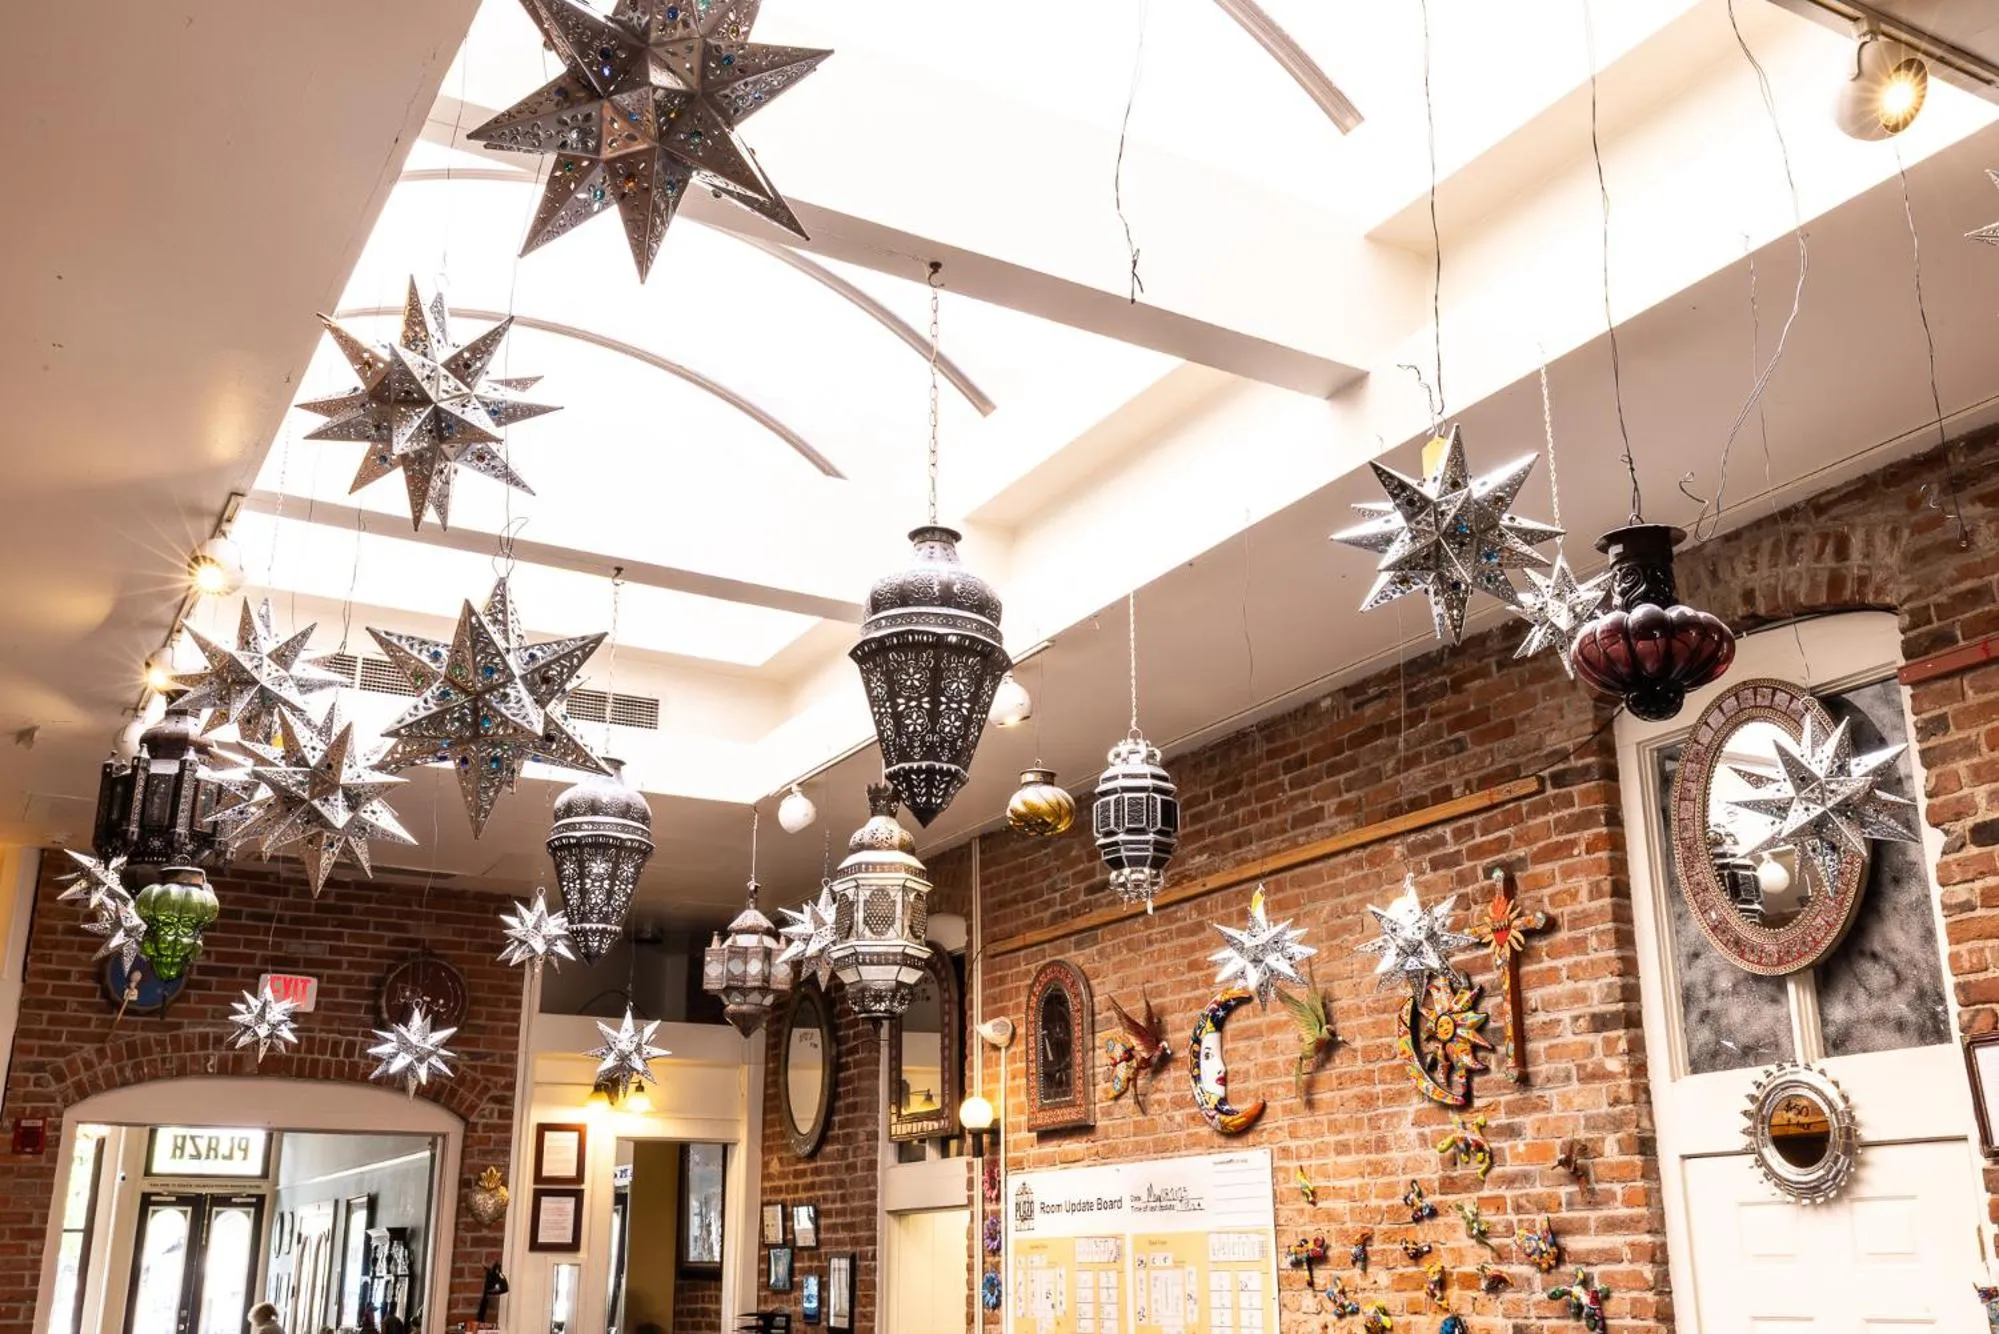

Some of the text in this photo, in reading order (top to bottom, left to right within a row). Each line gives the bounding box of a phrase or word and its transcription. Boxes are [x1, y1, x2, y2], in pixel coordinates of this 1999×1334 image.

[269, 975, 312, 1006] EXIT
[1040, 1196, 1123, 1215] Room Update Board
